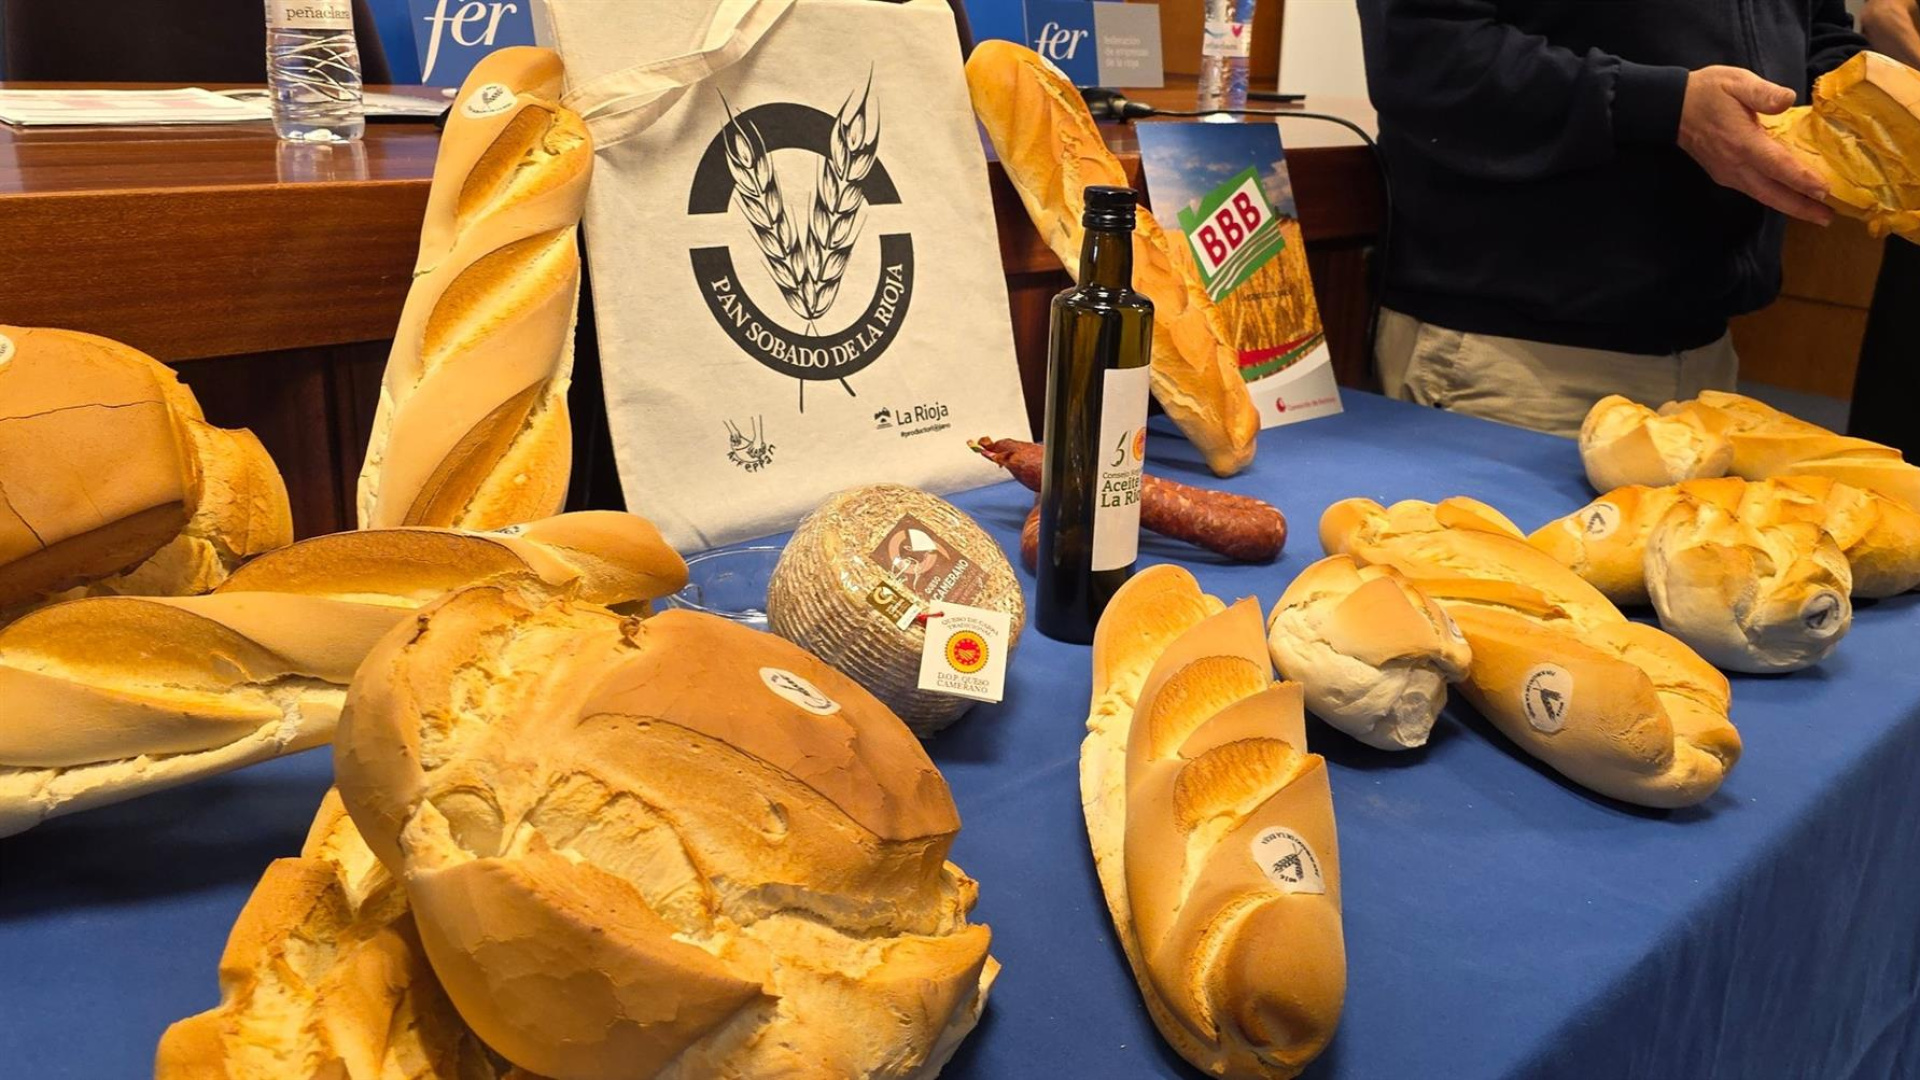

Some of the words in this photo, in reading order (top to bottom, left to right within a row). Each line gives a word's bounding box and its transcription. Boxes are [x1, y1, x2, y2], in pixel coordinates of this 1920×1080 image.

[286, 6, 350, 21] peñaclara
[422, 0, 518, 84] fer
[1034, 21, 1089, 60] fer
[1198, 191, 1261, 268] BBB
[711, 275, 752, 328] PAN
[745, 321, 829, 368] SOBADO
[830, 339, 861, 367] DE
[856, 323, 884, 352] LA
[874, 263, 904, 327] RIOJA
[895, 409, 912, 426] La
[914, 401, 949, 422] Rioja
[1100, 493, 1121, 508] La
[924, 576, 941, 594] QUESO
[933, 559, 969, 601] CAMERANO
[936, 679, 989, 694] CAMERANO
[961, 675, 990, 687] QUESO
